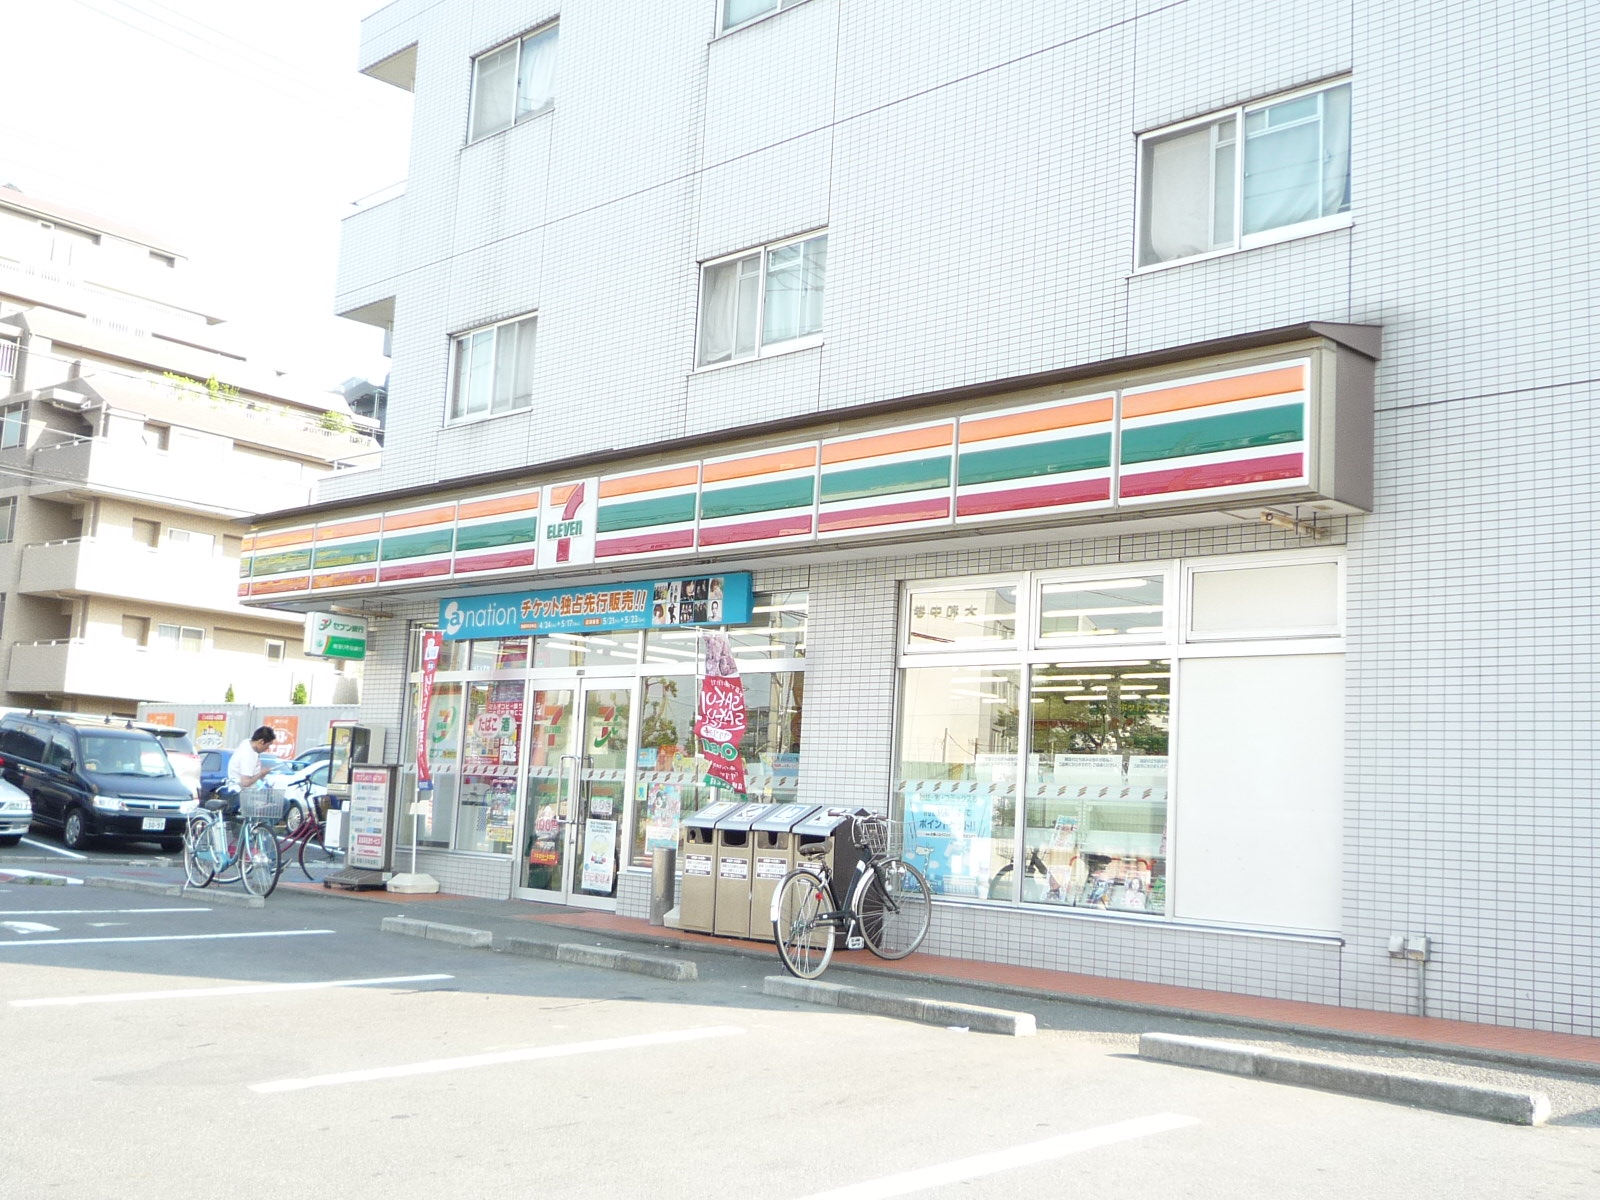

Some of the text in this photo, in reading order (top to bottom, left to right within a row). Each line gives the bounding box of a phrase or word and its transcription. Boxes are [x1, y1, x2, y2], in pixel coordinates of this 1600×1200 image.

[478, 717, 498, 732] たばこ
[500, 717, 511, 732] 酒
